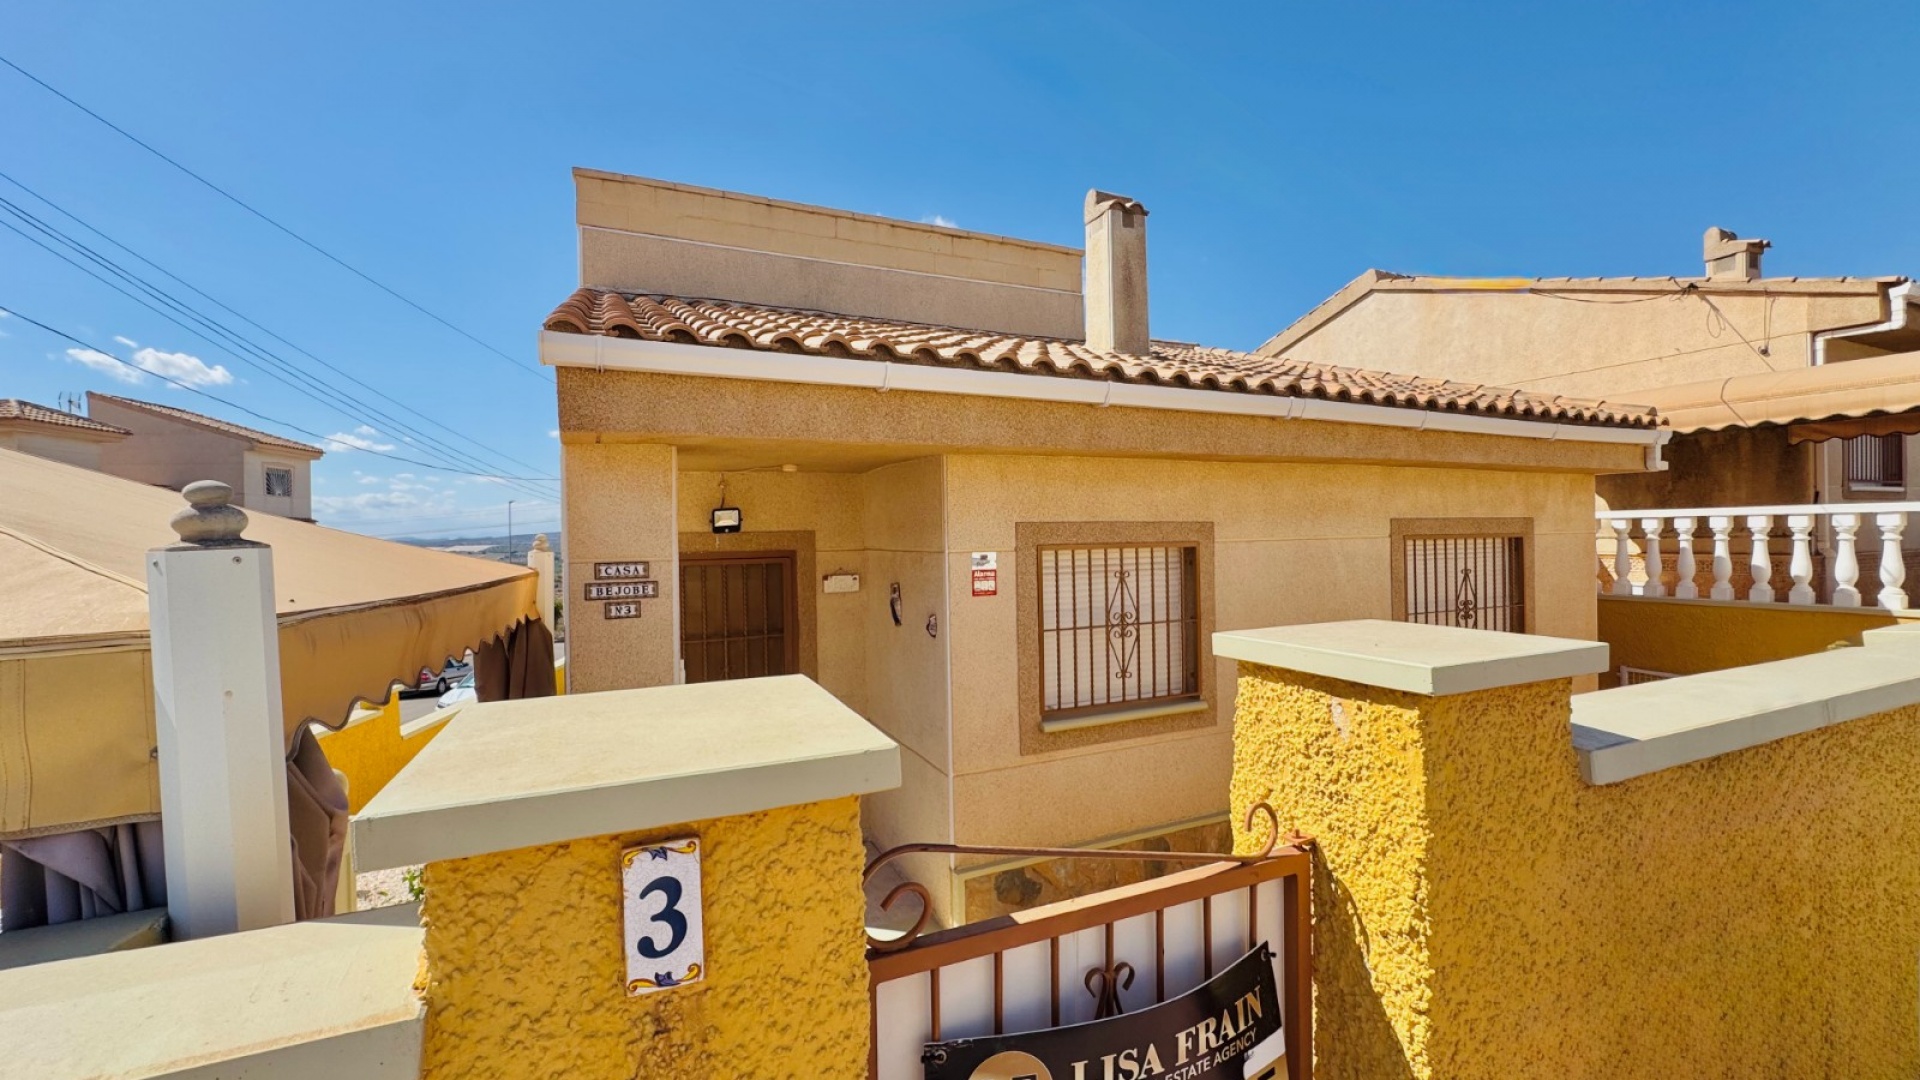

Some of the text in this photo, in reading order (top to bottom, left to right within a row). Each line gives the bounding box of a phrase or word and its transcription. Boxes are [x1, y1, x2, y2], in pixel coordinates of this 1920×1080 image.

[596, 585, 649, 596] BEJOBE
[604, 566, 640, 576] CASA
[637, 876, 688, 959] 3
[1071, 985, 1262, 1080] LISA FRAIN
[1213, 1027, 1257, 1067] AGENCY
